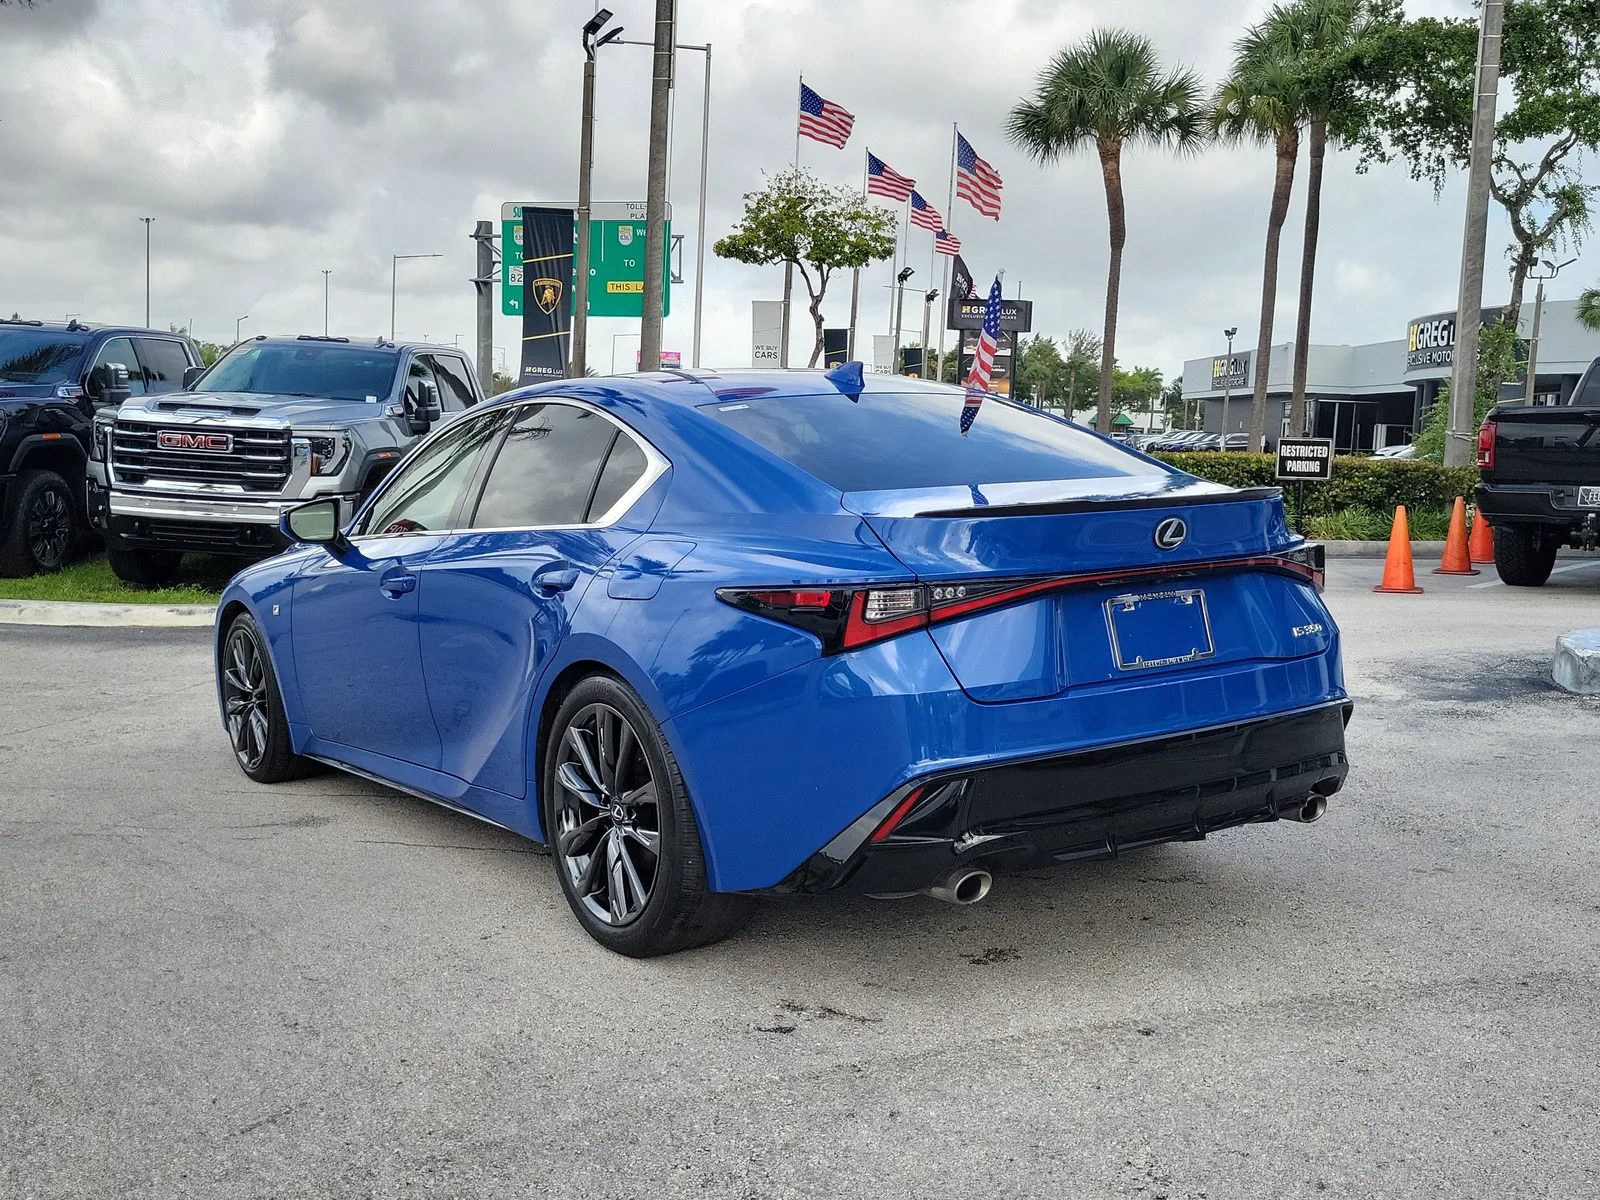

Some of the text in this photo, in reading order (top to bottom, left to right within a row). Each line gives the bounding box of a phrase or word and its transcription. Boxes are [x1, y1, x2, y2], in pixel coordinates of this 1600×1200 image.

[623, 259, 636, 267] TO
[610, 283, 631, 291] THIS
[754, 351, 778, 360] CARS
[161, 433, 227, 450] GMC
[1280, 444, 1329, 458] RESTRICTED
[1286, 460, 1321, 473] PARKING
